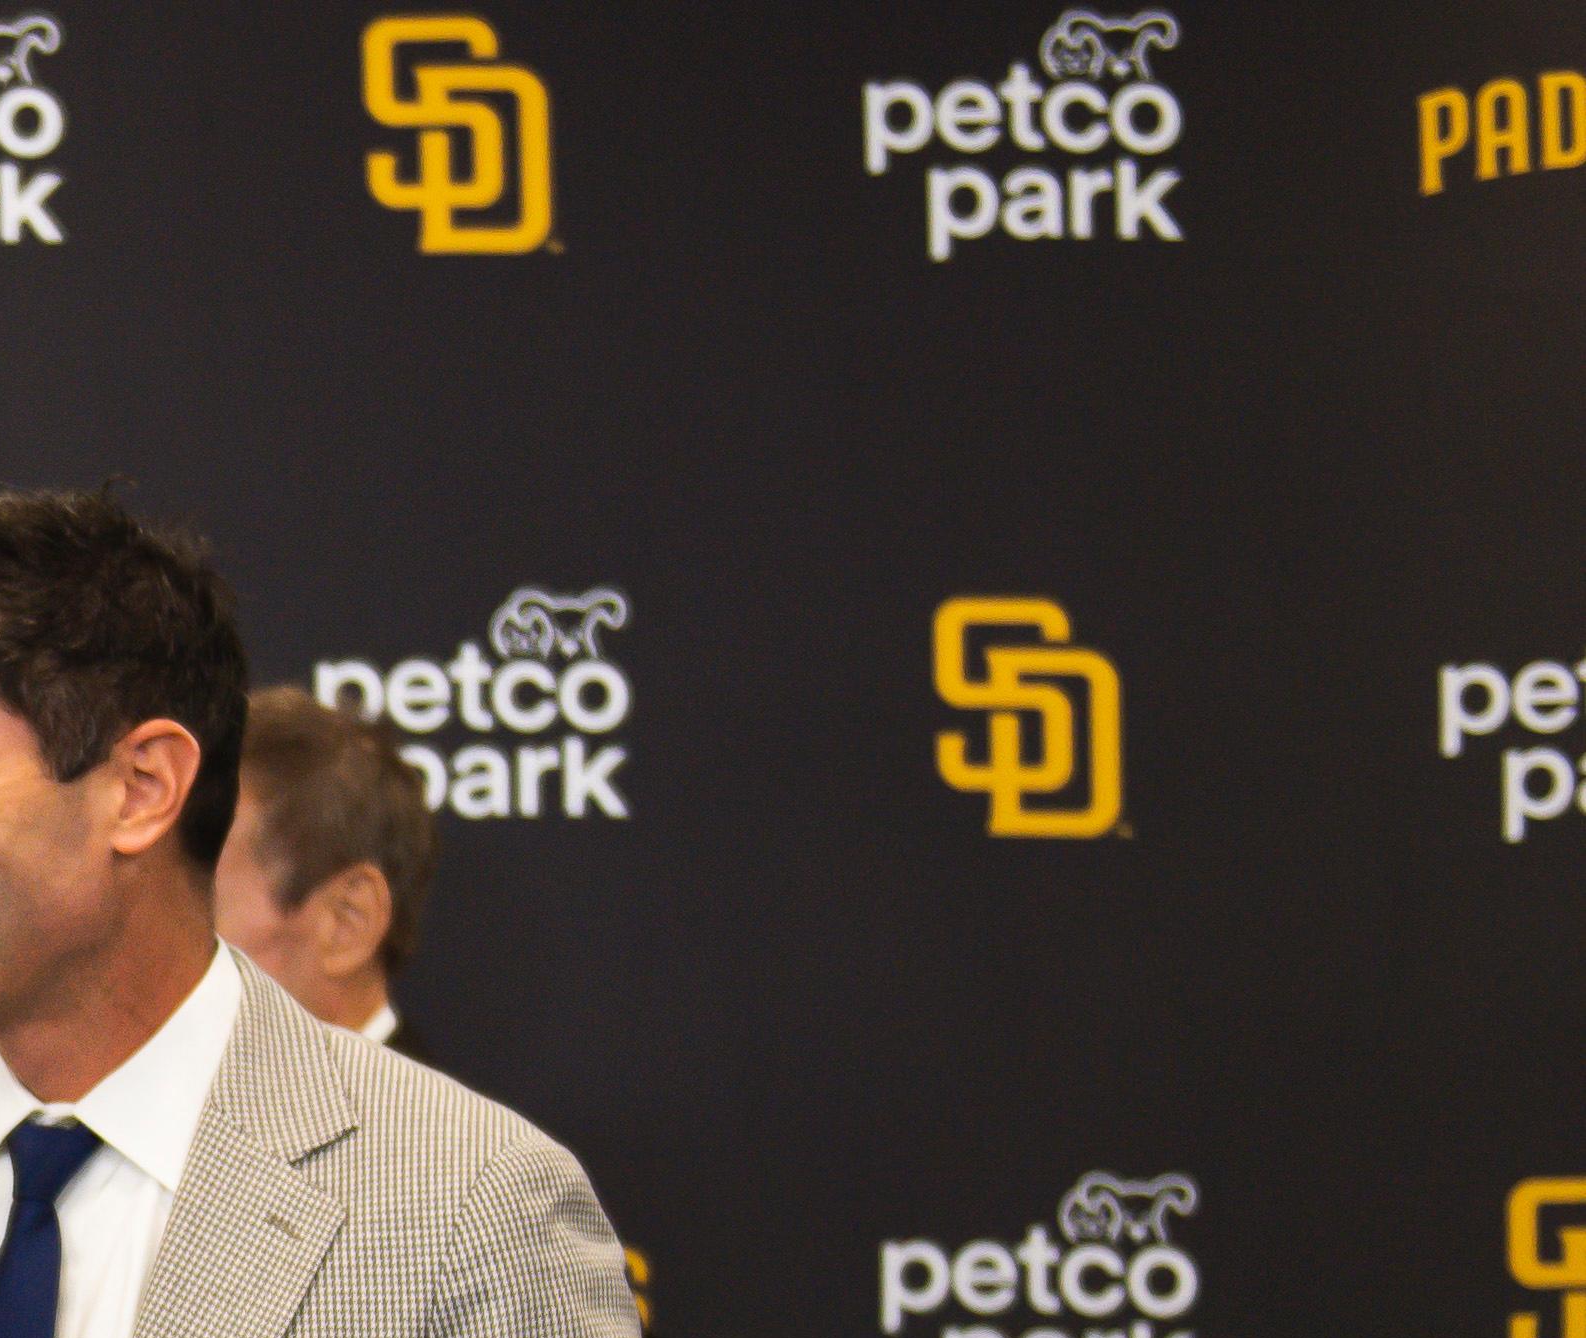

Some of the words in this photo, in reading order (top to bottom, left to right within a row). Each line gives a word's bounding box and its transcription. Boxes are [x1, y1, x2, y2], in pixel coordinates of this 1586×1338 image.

[362, 16, 551, 255] SD
[863, 60, 1183, 176] petco
[1417, 70, 1586, 197] PAD
[926, 158, 1183, 262] park
[933, 597, 1121, 838] SD
[881, 1225, 1199, 1333] petco
